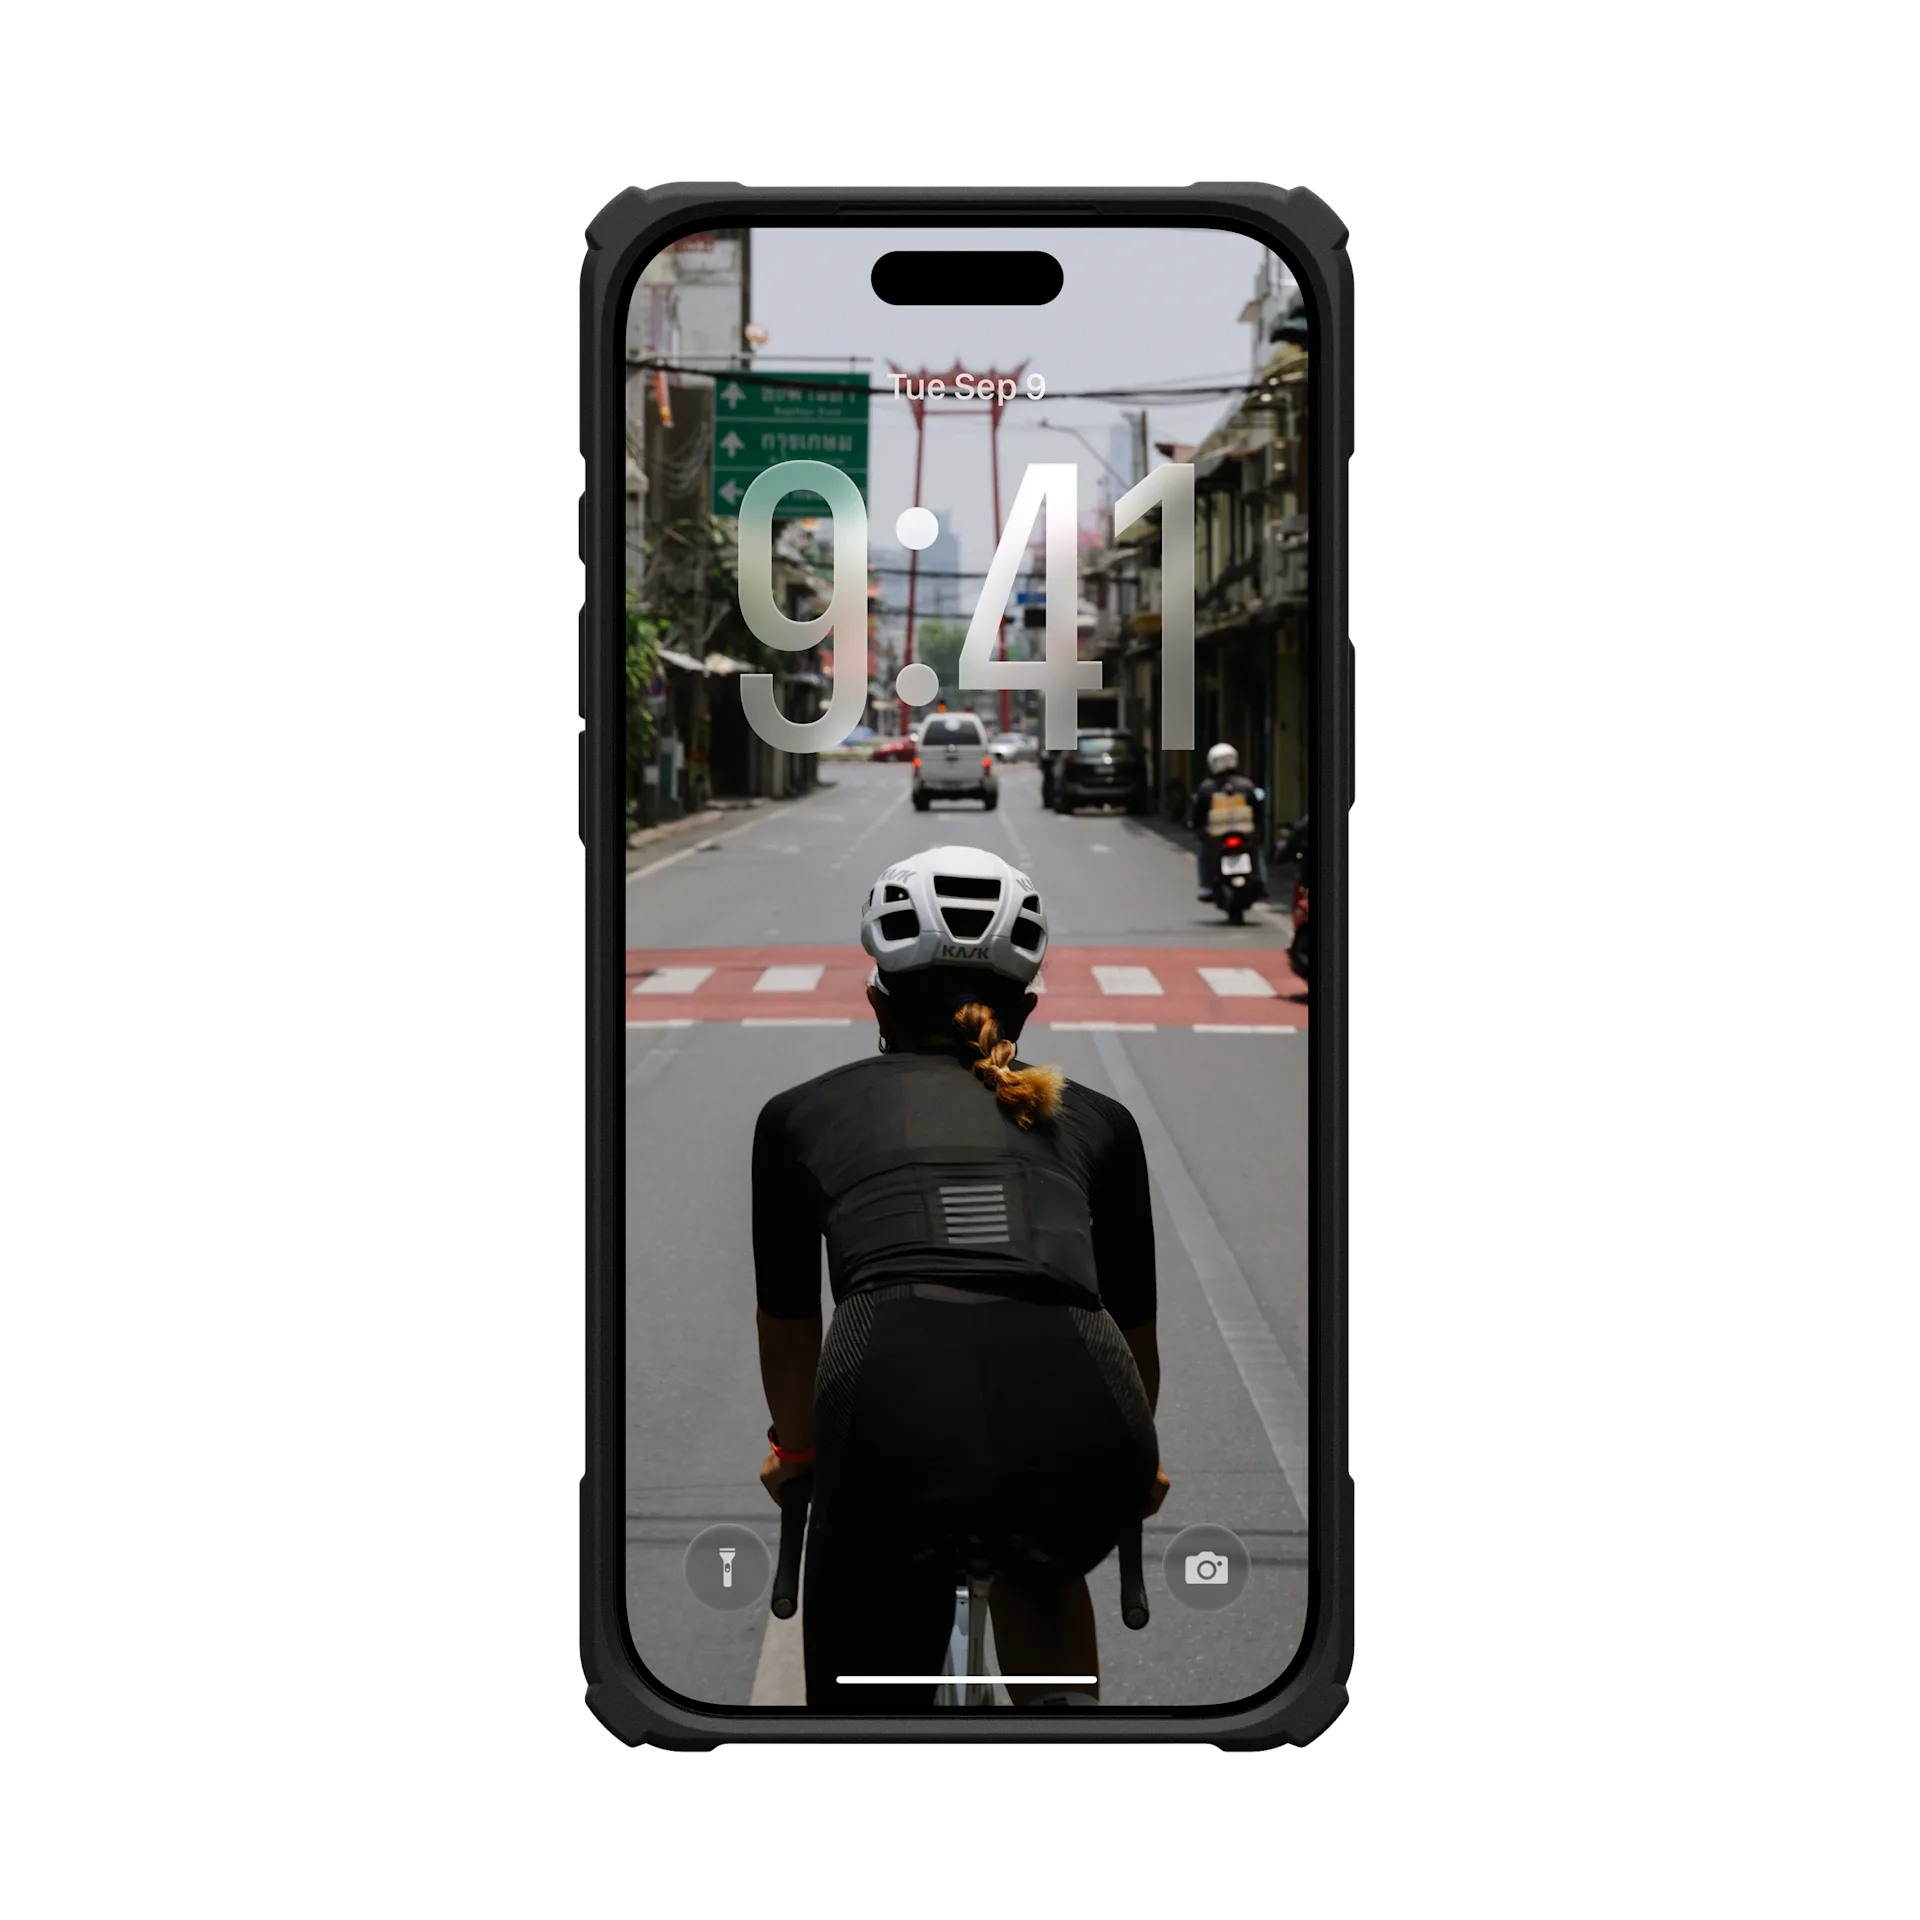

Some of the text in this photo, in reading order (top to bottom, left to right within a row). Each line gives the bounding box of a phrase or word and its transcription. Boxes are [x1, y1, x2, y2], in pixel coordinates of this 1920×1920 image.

[887, 373, 1046, 406] Tue Sep 9
[738, 460, 1195, 754] 9:41
[943, 945, 991, 960] KASK
